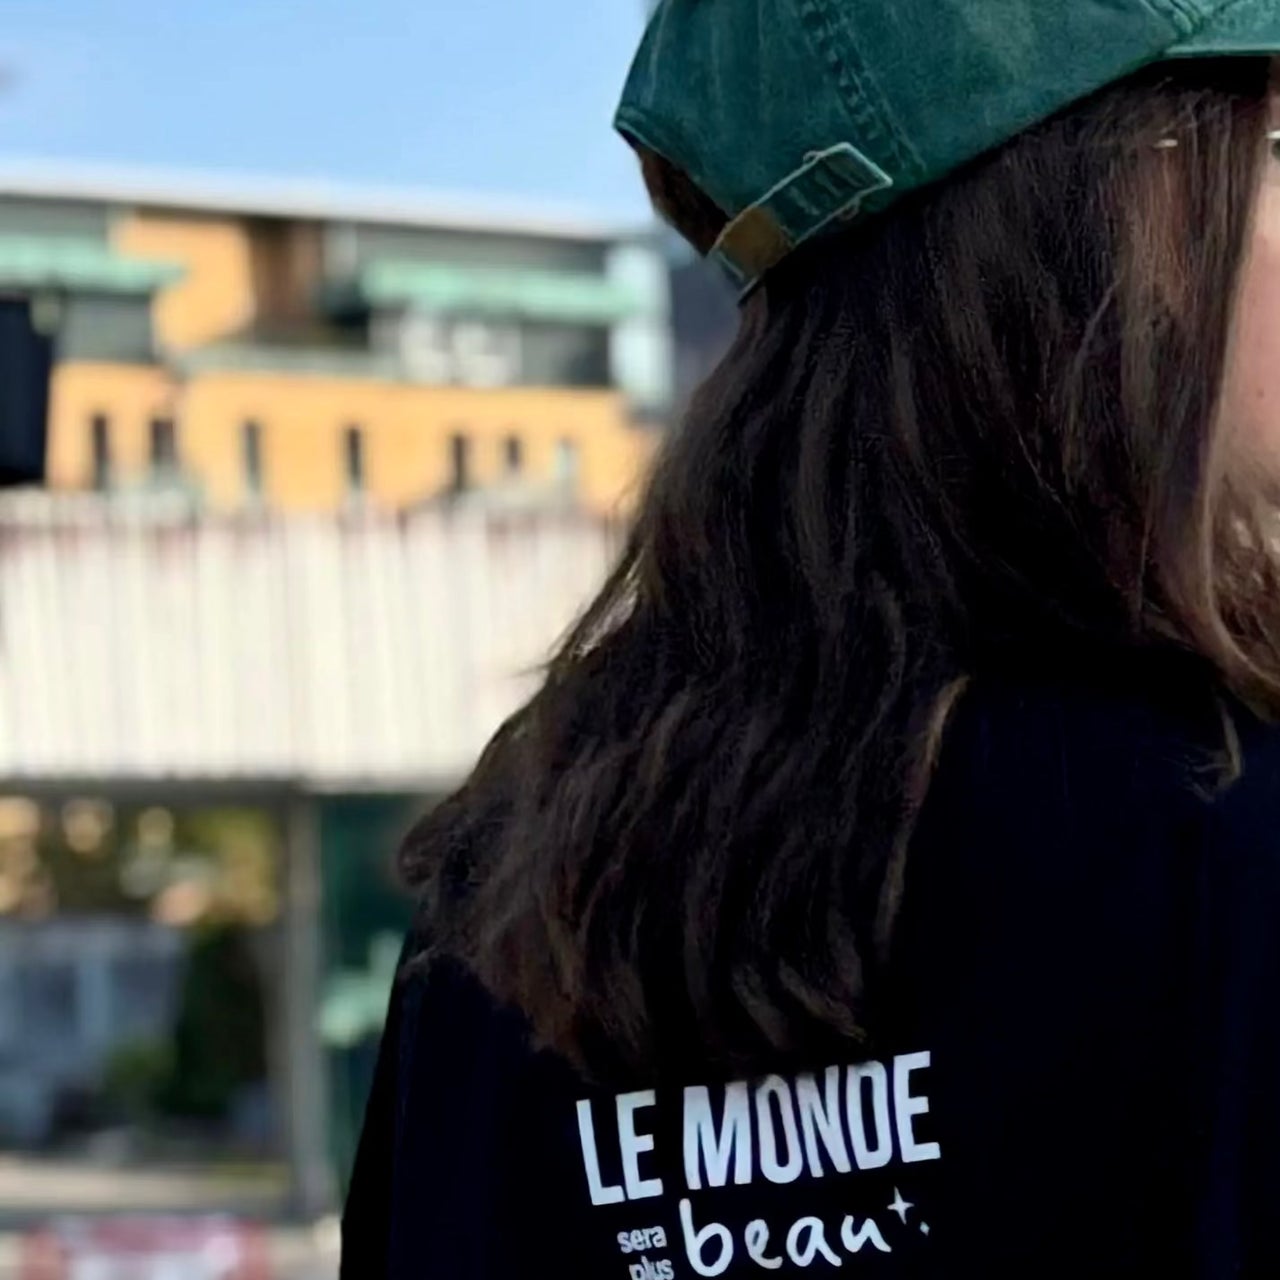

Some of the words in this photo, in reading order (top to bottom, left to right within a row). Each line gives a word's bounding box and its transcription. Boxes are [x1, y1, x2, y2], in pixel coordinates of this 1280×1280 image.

[576, 1089, 664, 1206] LE
[682, 1050, 941, 1191] MONDE
[617, 1225, 667, 1254] sera
[678, 1198, 892, 1278] beau
